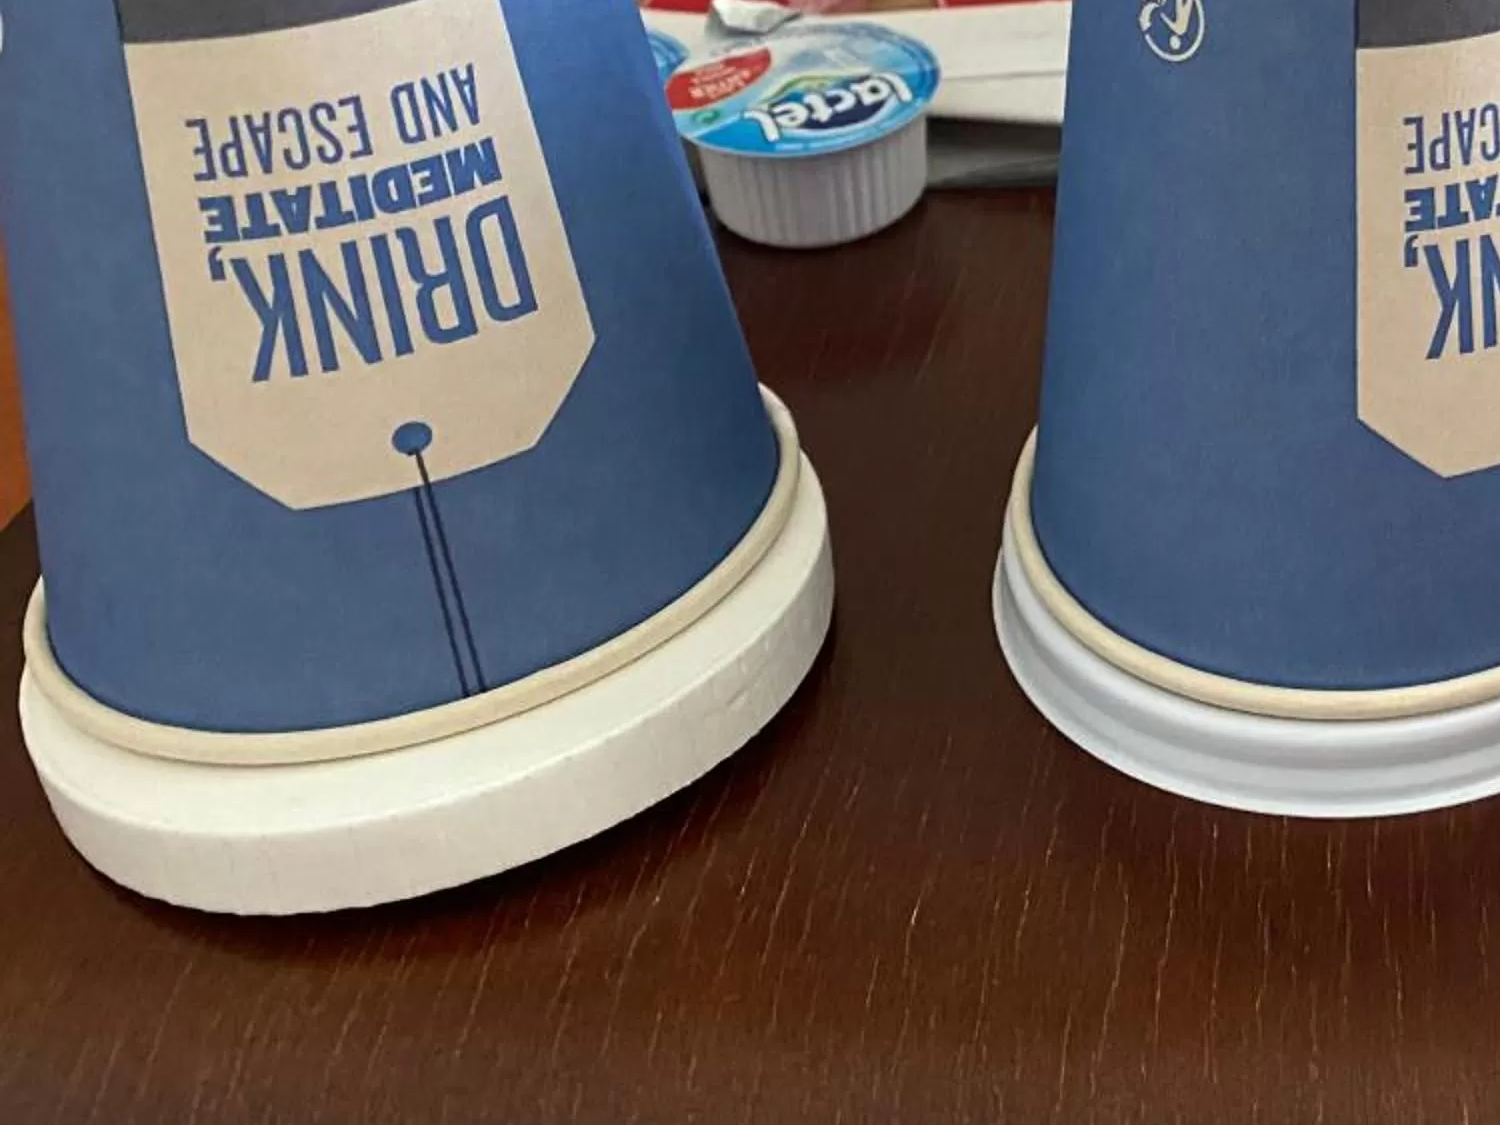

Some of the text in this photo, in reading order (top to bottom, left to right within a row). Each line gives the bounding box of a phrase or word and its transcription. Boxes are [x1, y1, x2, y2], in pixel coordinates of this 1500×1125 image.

[184, 62, 481, 182] AND ESCAPE
[744, 73, 914, 143] lactel
[197, 136, 503, 244] MEDITATE
[207, 194, 540, 383] DRINK,
